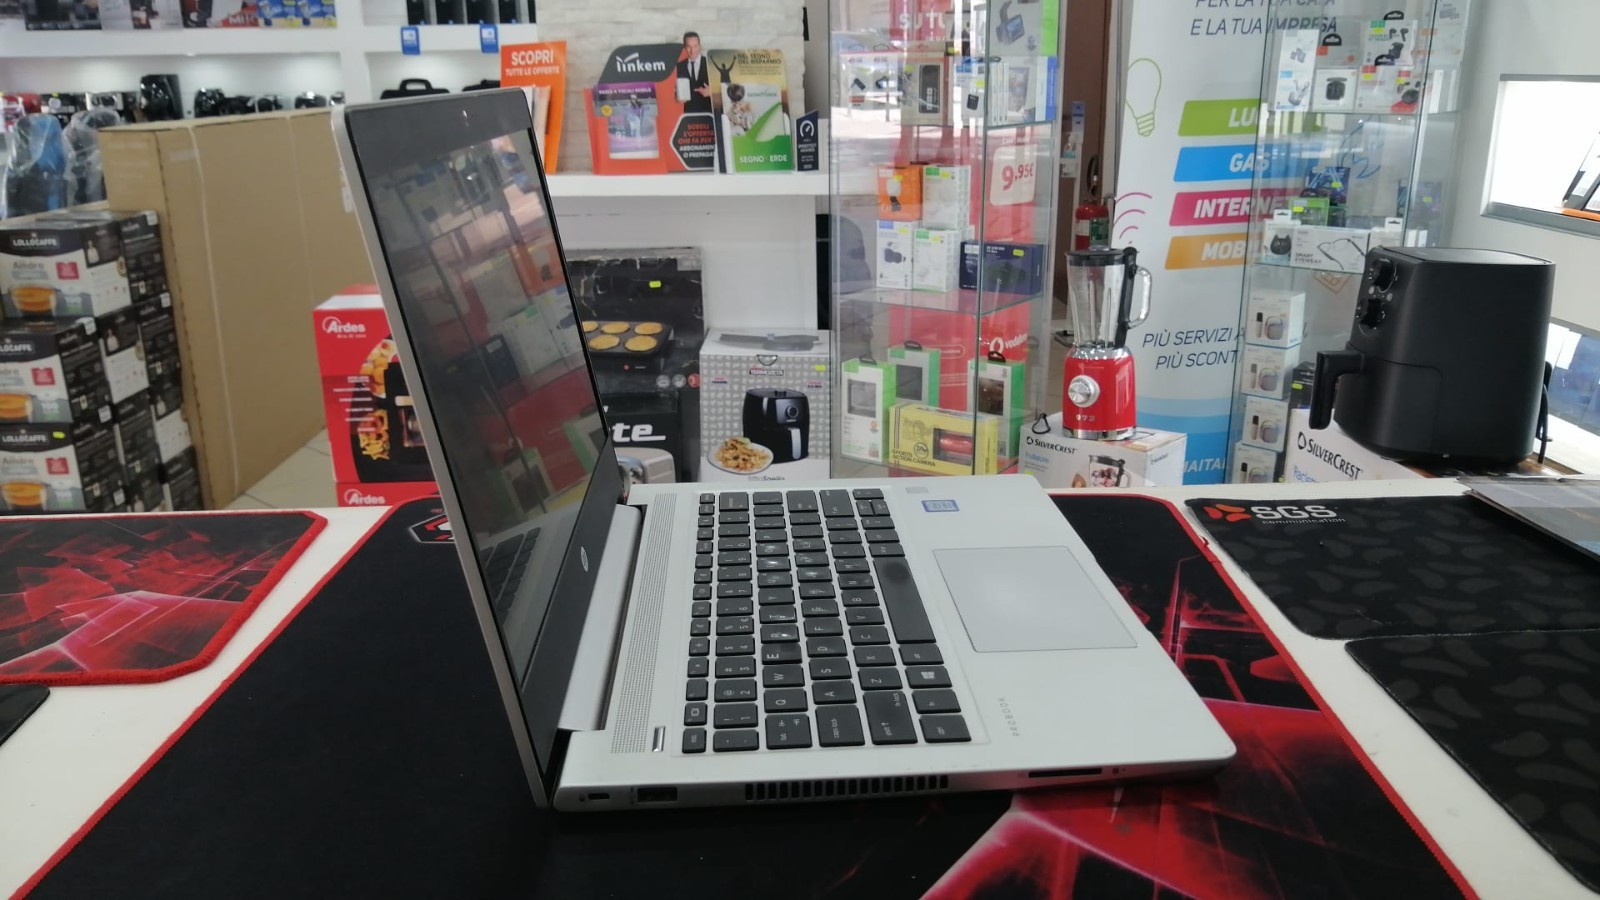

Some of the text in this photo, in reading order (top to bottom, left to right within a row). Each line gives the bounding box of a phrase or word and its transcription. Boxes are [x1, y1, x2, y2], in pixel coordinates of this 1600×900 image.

[1190, 19, 1203, 35] E
[1205, 18, 1227, 35] LA
[1232, 18, 1262, 34] TUA
[511, 49, 554, 66] SCOPRI
[616, 55, 666, 72] linkem
[505, 65, 560, 77] TUTTE LE OFFERTE
[739, 154, 787, 163] SEGNO ERDE
[1229, 152, 1271, 173] GAS
[1193, 196, 1286, 219] INTERNE
[326, 320, 366, 334] Ardes
[1142, 329, 1171, 348] PIÙ
[1173, 327, 1233, 346] SERVIZI
[1155, 349, 1240, 370] PIÙ SCONT
[611, 422, 667, 442] te
[1034, 438, 1077, 454] SILVERCREST
[1307, 438, 1361, 480] SILVERCREST
[348, 493, 386, 505] Ardes
[1250, 504, 1337, 520] SGS
